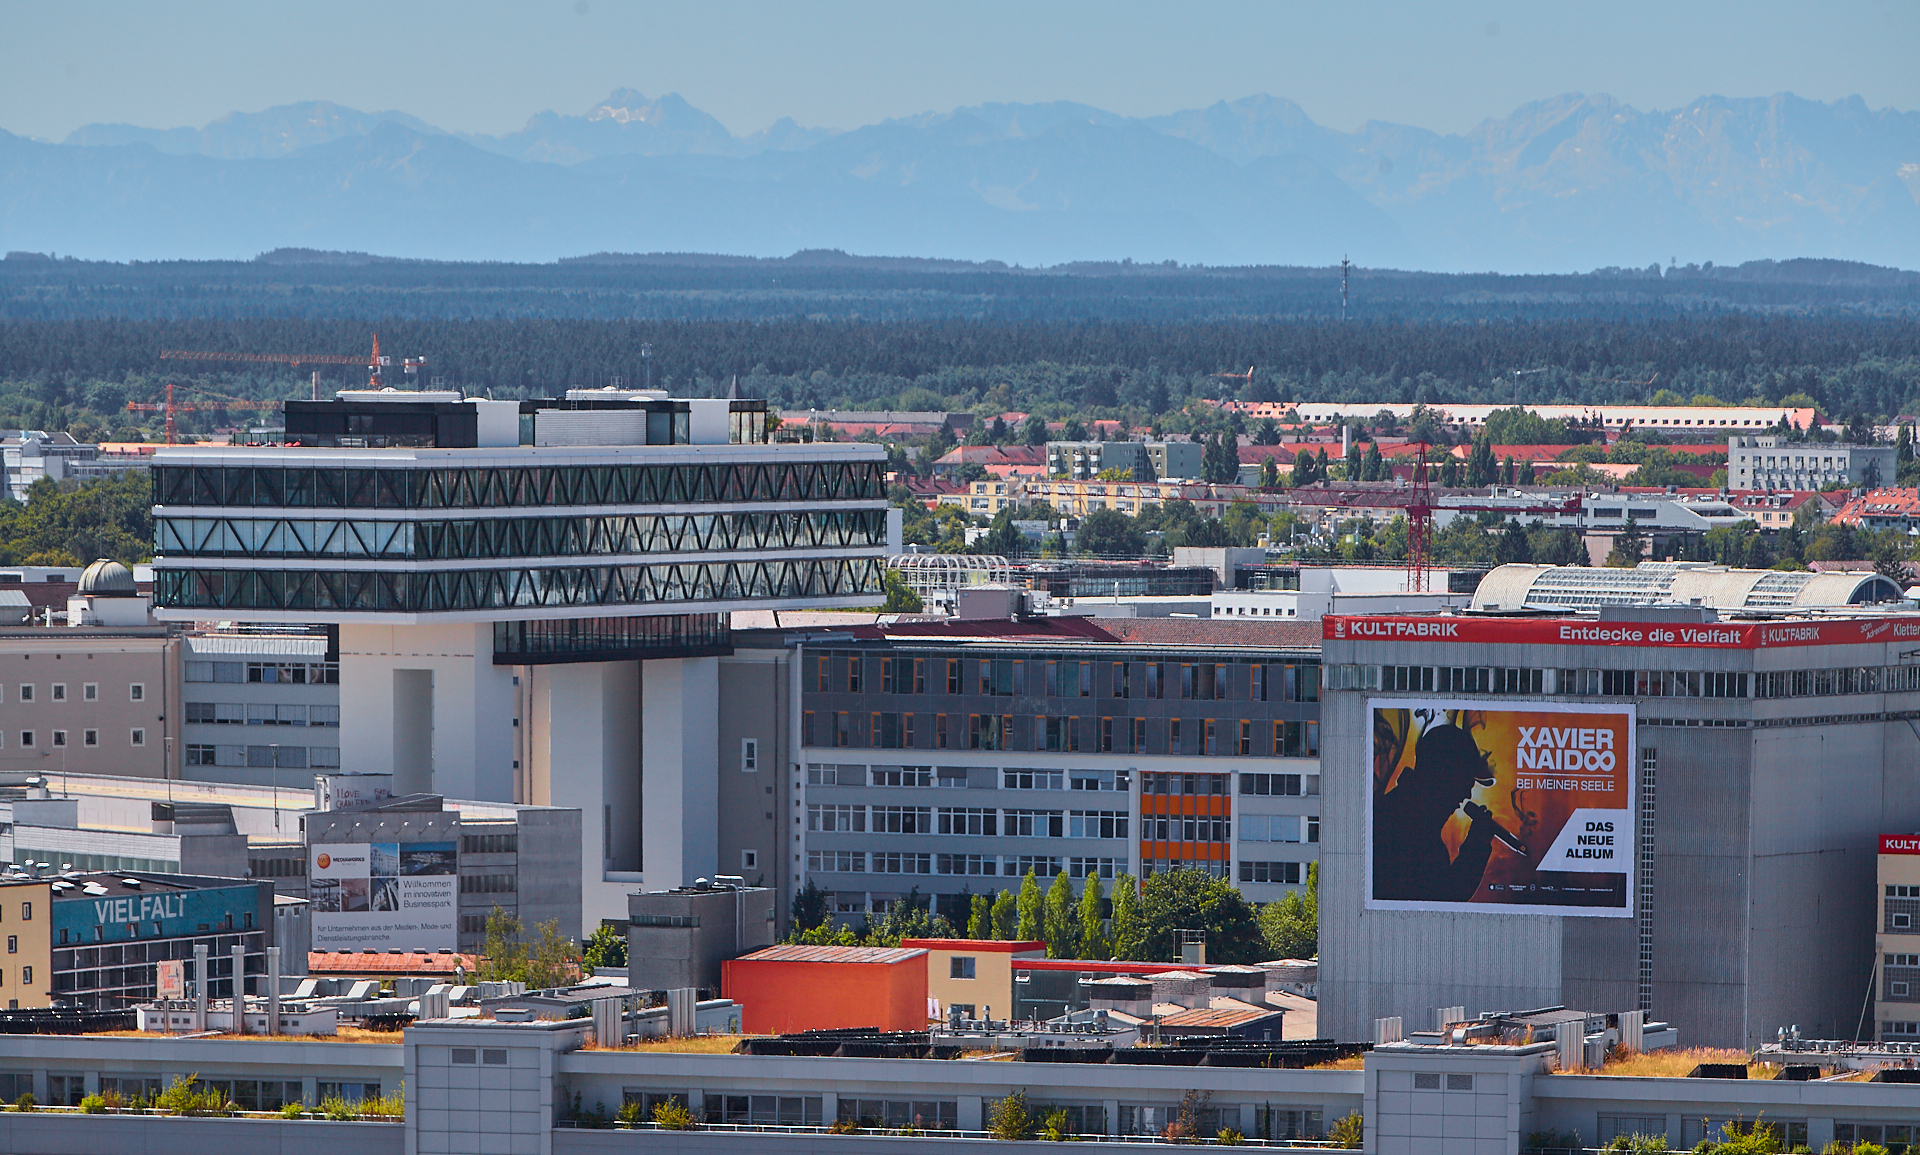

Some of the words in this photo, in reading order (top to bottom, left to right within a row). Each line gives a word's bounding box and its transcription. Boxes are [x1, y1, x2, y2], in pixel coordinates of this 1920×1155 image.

[1350, 621, 1459, 637] KULTFABRIK
[1559, 625, 1643, 642] Entdecke
[1648, 628, 1675, 642] die
[1680, 628, 1742, 644] Vielfalt
[1768, 626, 1820, 642] KULTFABRIK
[1517, 726, 1615, 750] XAVIER
[1516, 748, 1616, 772] NAIDOO
[1516, 778, 1534, 789] BEI
[1536, 778, 1579, 791] MEINER
[1580, 780, 1615, 792] SEELE
[1585, 821, 1614, 833] DAS
[1577, 835, 1614, 846] NEUE
[1885, 839, 1920, 850] KULT
[1565, 848, 1614, 859] ALBUM
[403, 880, 452, 889] Willkommen
[403, 890, 412, 898] im
[413, 889, 452, 898] innovativen
[94, 893, 187, 924] VIELFALT
[403, 899, 452, 909] Businesspark
[327, 924, 370, 932] Unternehmen
